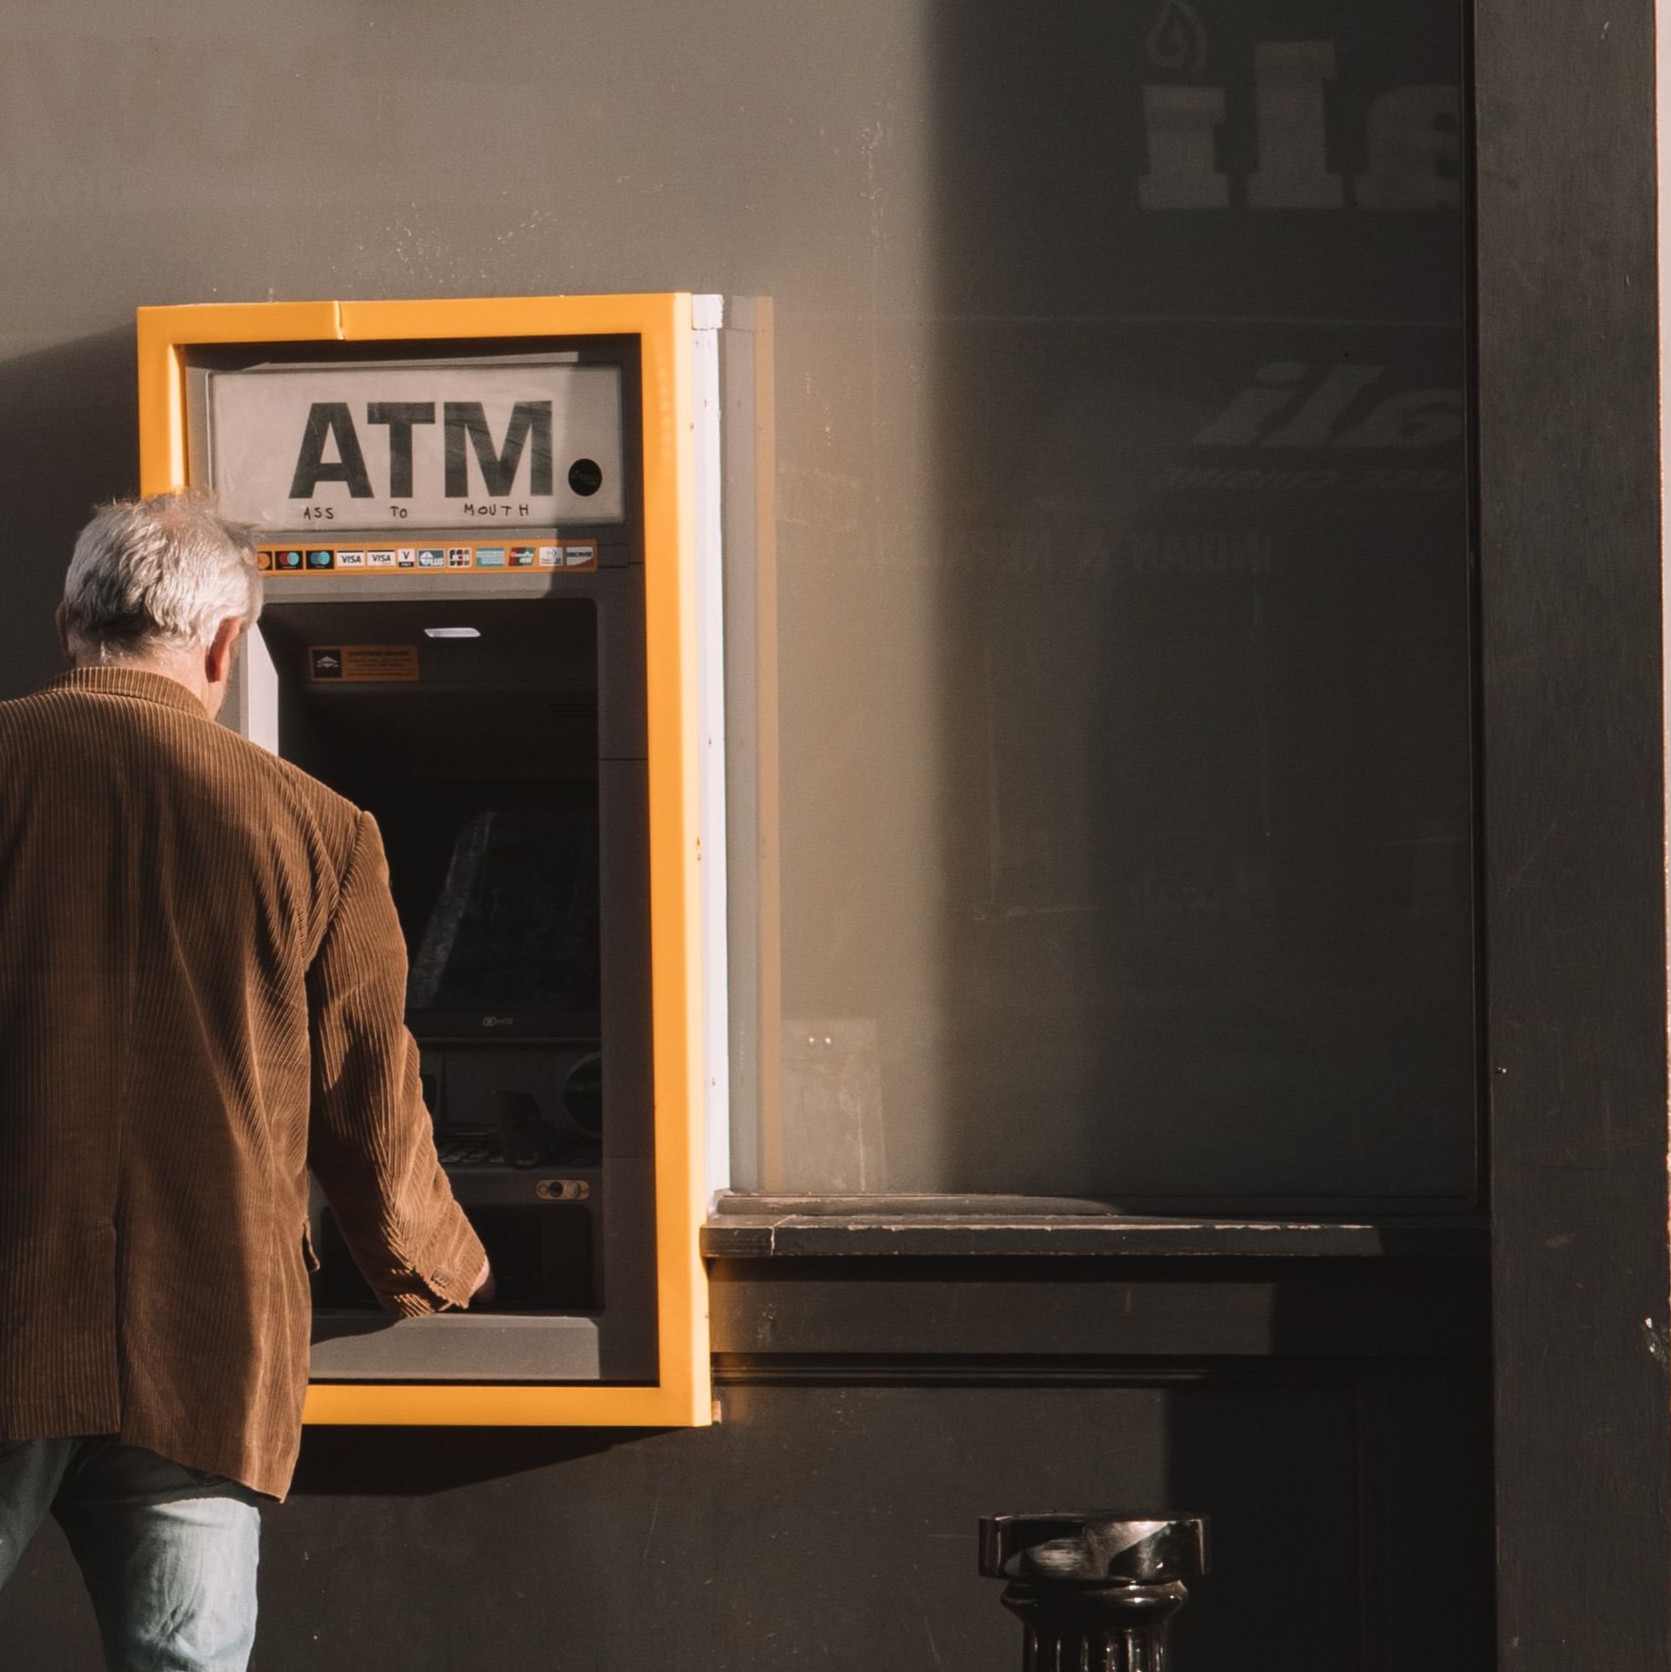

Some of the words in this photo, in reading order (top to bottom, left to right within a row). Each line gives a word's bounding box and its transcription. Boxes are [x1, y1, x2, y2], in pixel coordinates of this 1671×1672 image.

[289, 401, 553, 498] ATM
[303, 506, 334, 520] ASS
[390, 506, 408, 519] TO
[464, 503, 530, 517] MOUTH
[341, 555, 362, 564] VISA
[372, 554, 392, 562] VISA
